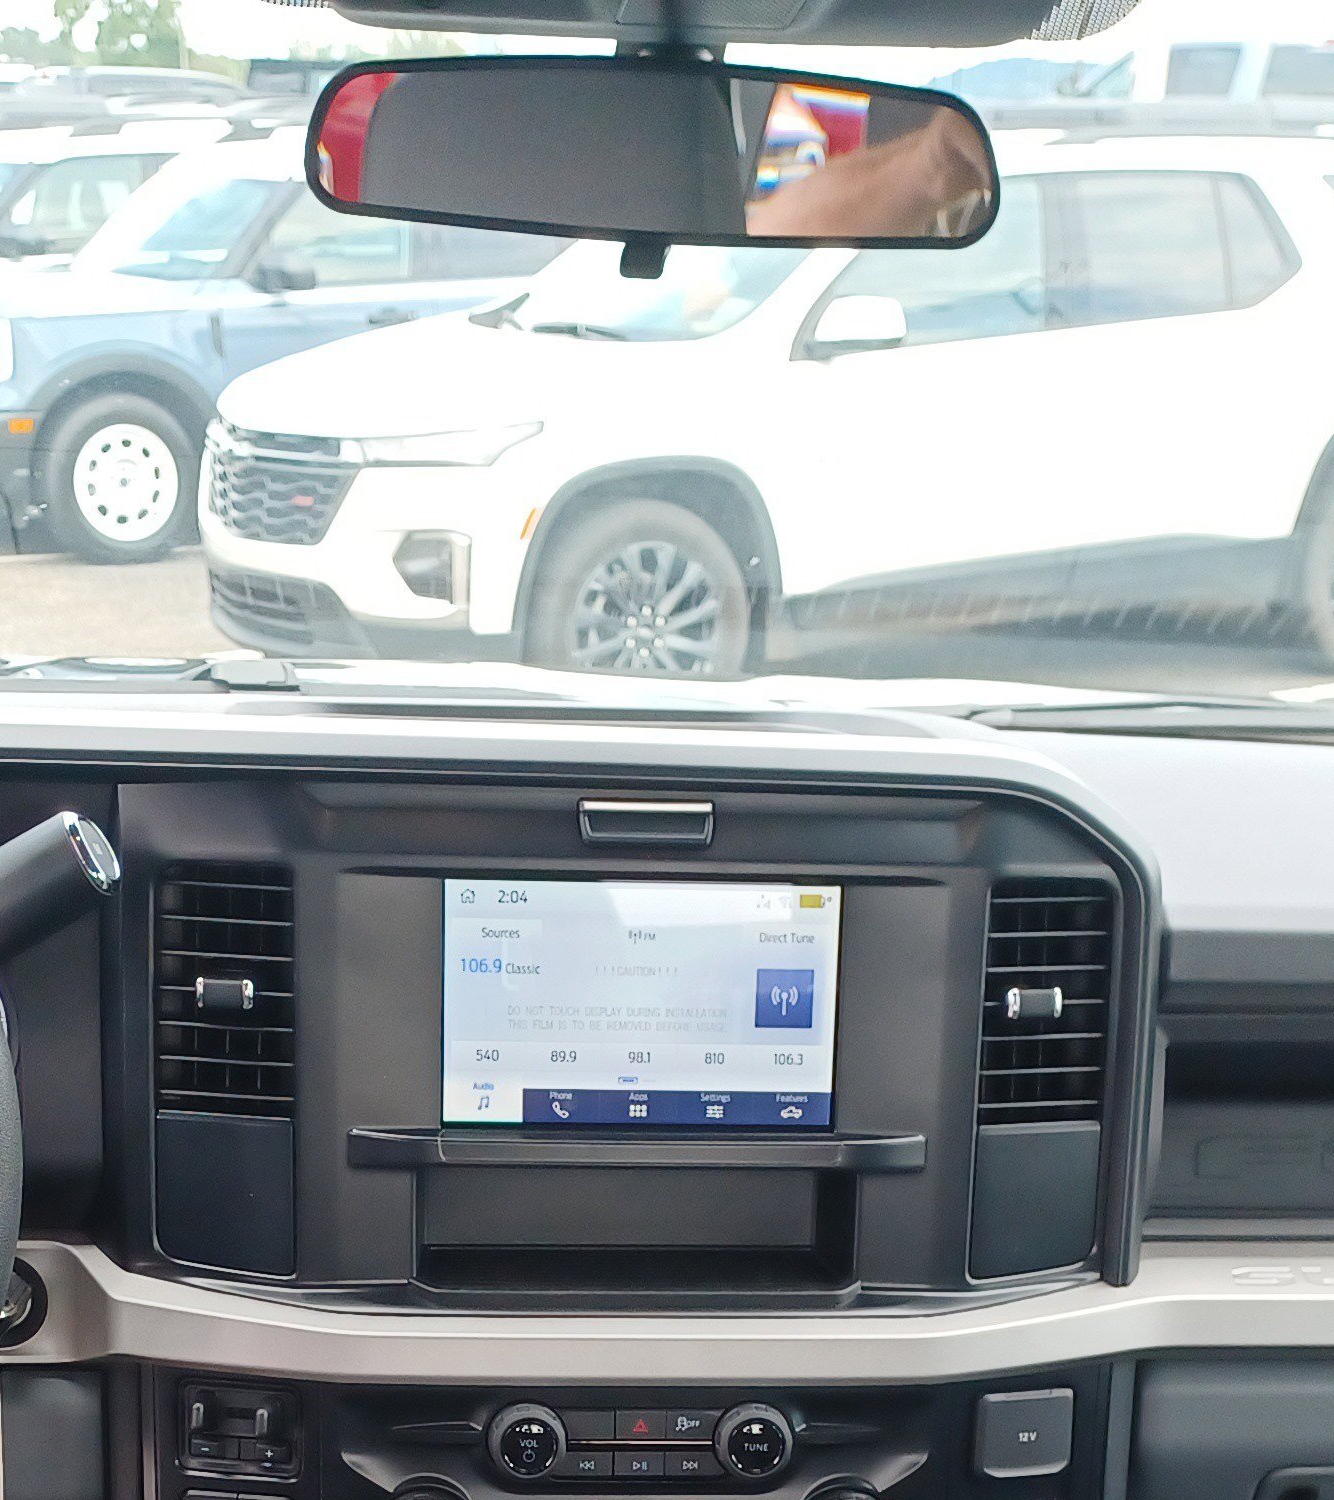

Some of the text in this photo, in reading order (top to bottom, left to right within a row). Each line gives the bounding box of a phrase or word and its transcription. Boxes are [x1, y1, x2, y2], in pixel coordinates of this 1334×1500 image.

[497, 890, 528, 904] 2:04
[481, 927, 521, 938] Sources
[759, 932, 815, 944] Direct Tune
[461, 958, 541, 975] 106.9 Classic
[507, 1005, 521, 1016] DO
[572, 1020, 585, 1030] TO
[475, 1048, 499, 1062] 540
[550, 1050, 577, 1062] 89.9
[628, 1051, 651, 1064] 98.1
[705, 1052, 725, 1065] 810
[774, 1053, 804, 1066] 106.3
[473, 1082, 495, 1091] Audio
[549, 1091, 573, 1100] Phone
[629, 1092, 649, 1102] Apps
[700, 1092, 731, 1103] Settings
[775, 1094, 809, 1103] Features
[519, 1438, 539, 1448] VOL
[743, 1442, 769, 1452] TUNE
